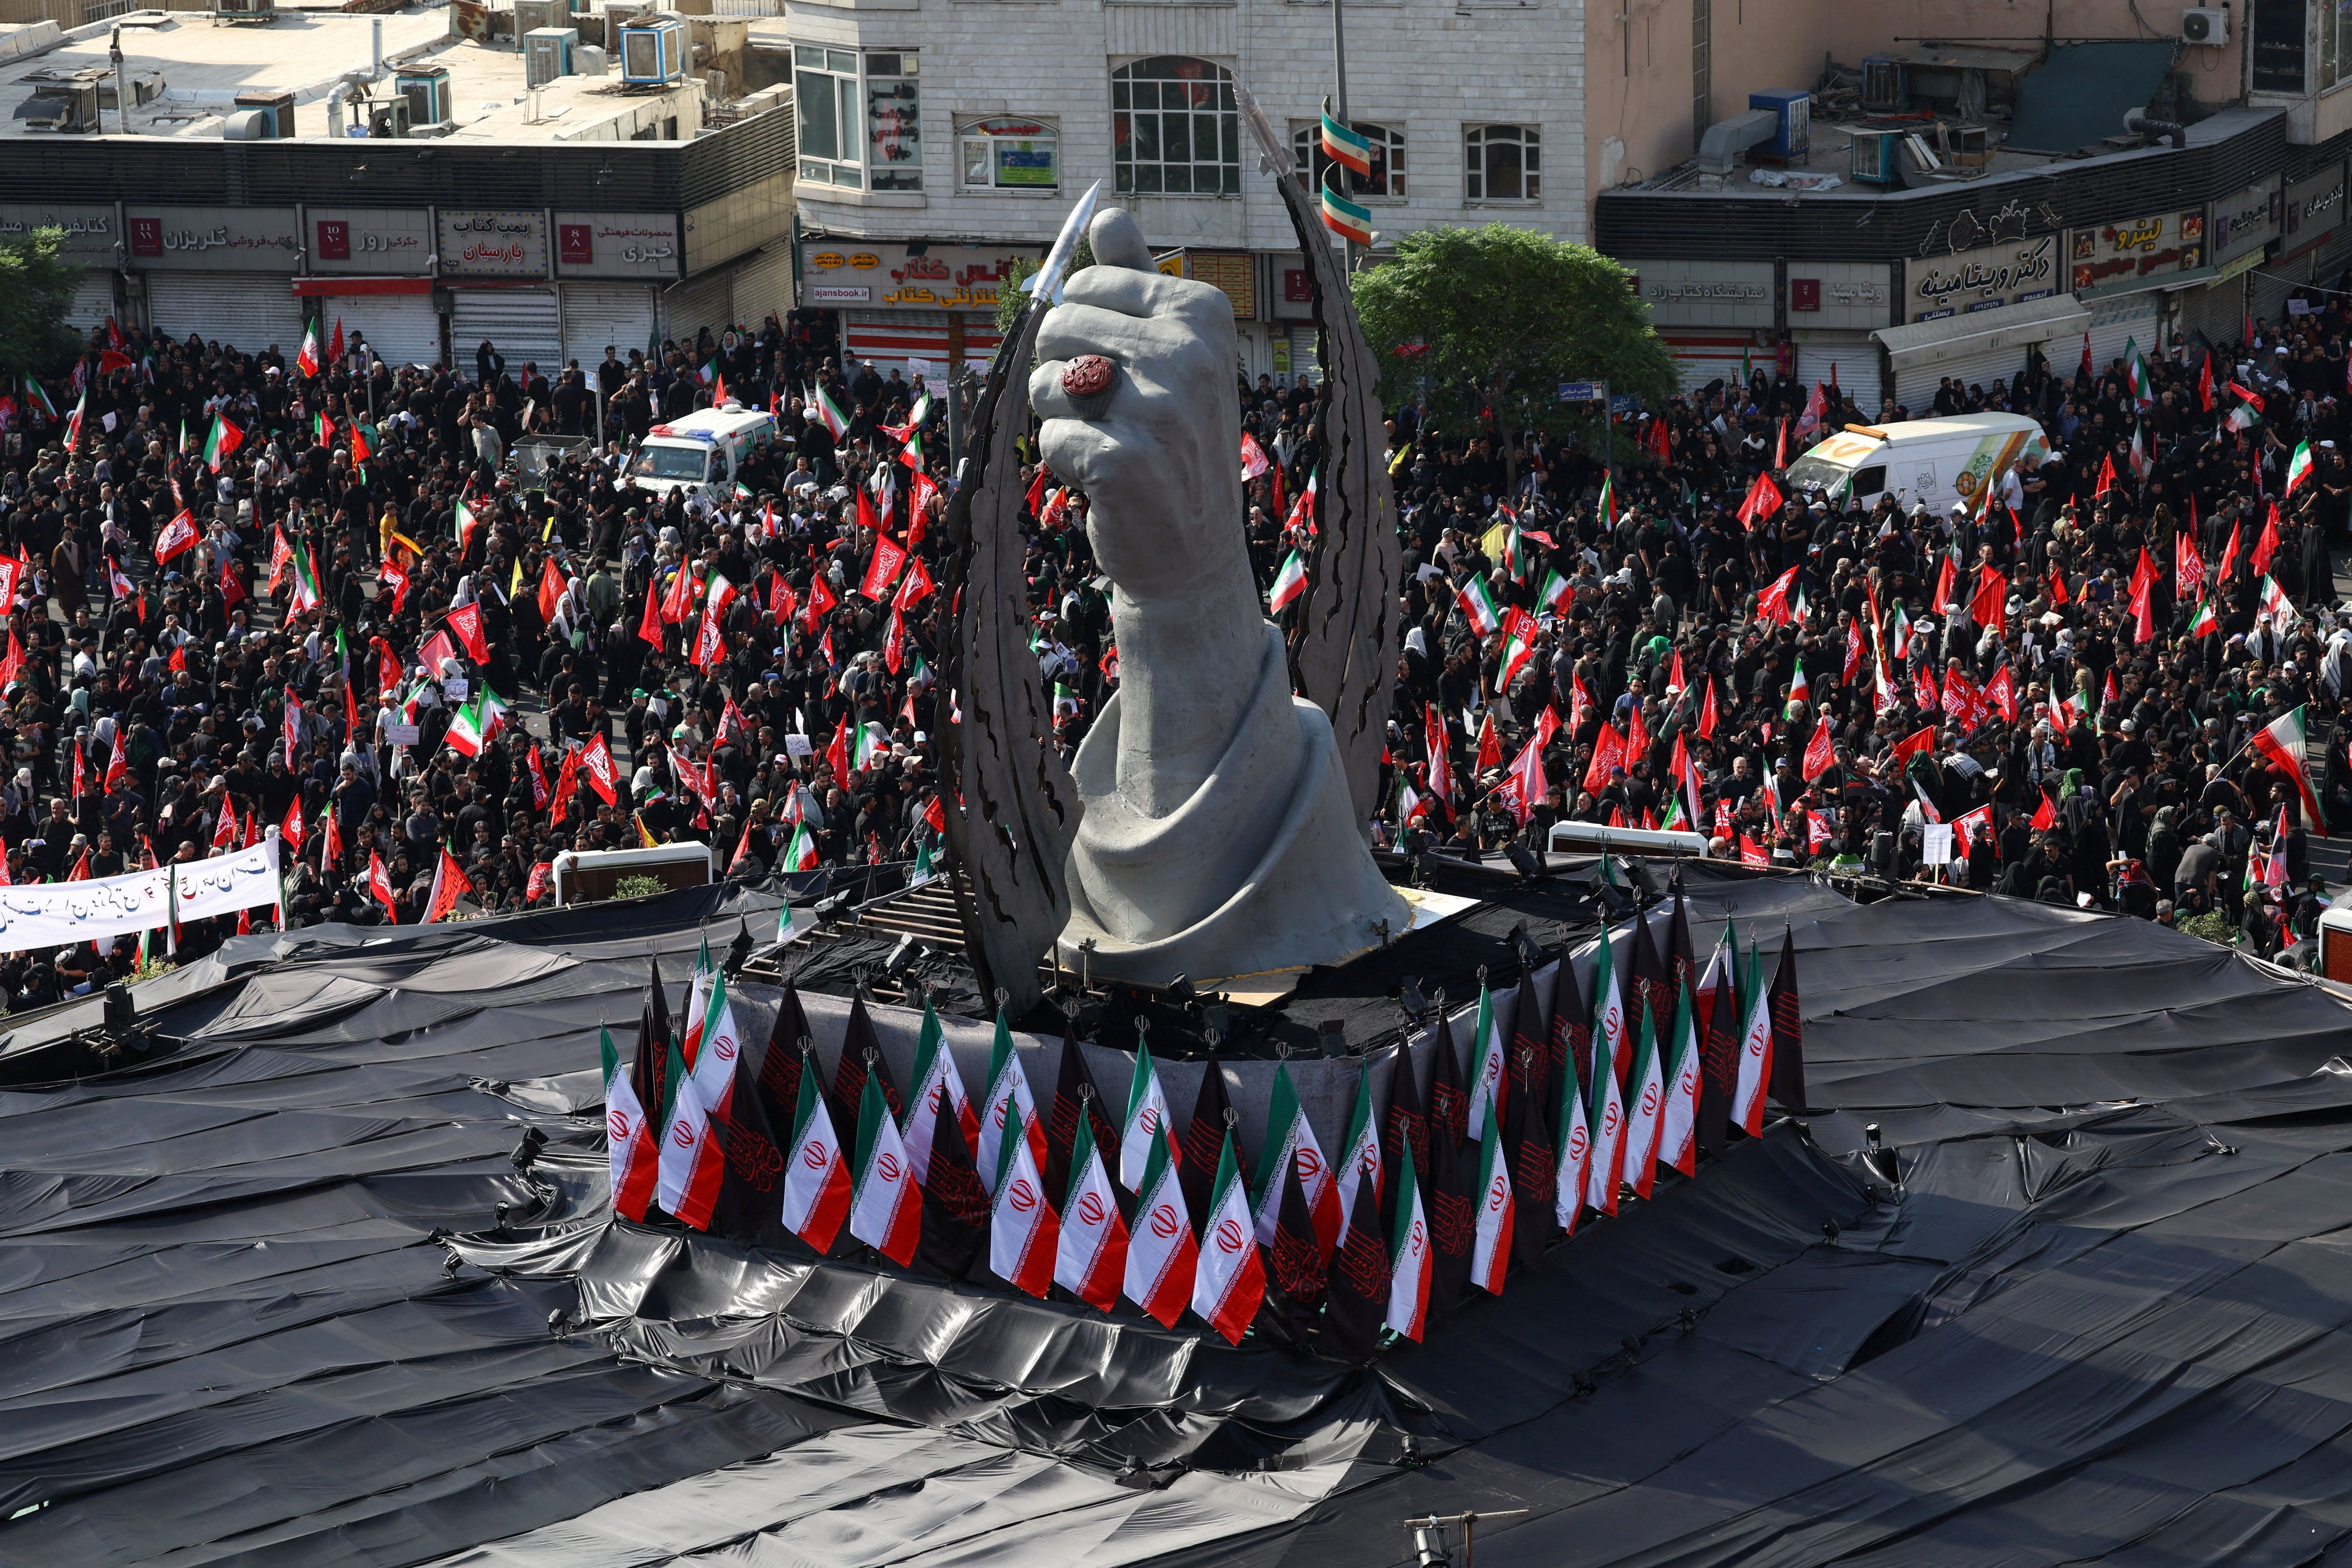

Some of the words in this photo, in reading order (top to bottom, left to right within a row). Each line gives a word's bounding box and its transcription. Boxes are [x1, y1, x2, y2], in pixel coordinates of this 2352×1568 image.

[2307, 195, 2323, 217] نظری
[326, 226, 339, 234] 10
[453, 216, 495, 238] کتاب
[496, 222, 529, 239] بمب
[571, 229, 580, 238] 8
[598, 227, 630, 238] فرهنگی
[631, 229, 672, 238] محصولات
[163, 226, 227, 250] گلریزان
[229, 235, 266, 249] فروشی
[267, 236, 292, 249] کتاب
[356, 231, 388, 251] روز
[390, 237, 418, 247] جگرکی
[463, 241, 523, 264] پارسیان
[622, 241, 672, 262] خیری
[891, 256, 949, 285] کتاب
[2011, 236, 2052, 289] دکتر
[1650, 285, 1667, 299] راد
[1668, 285, 1702, 300] کتاب
[1704, 283, 1765, 302] نمایشگاه
[1829, 281, 1883, 303] ویتامینه
[1921, 263, 2009, 305] ویتامینه
[815, 289, 867, 298] ajansbook.ir
[882, 287, 935, 306] کتاب
[938, 287, 1001, 308] نترنتی
[2023, 290, 2047, 301] آبمیوه
[1924, 310, 1950, 321] بستنی
[1613, 397, 1631, 408] کارگر
